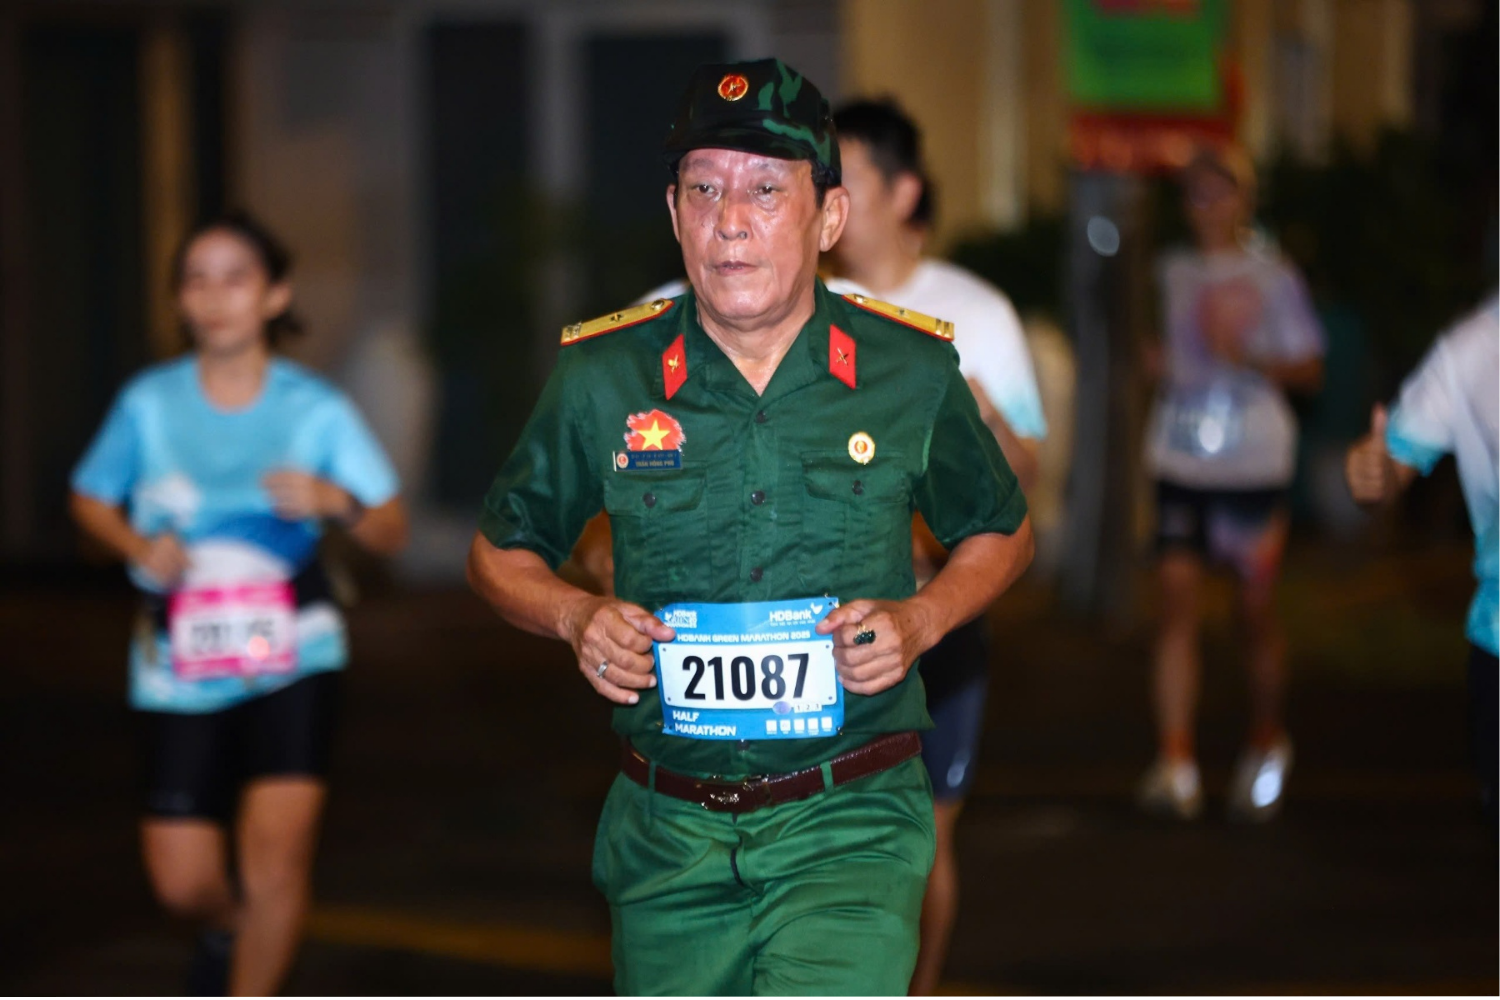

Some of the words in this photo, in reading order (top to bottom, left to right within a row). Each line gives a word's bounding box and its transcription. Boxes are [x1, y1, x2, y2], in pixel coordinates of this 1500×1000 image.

[769, 610, 811, 621] HDBank
[677, 633, 711, 643] HDBANK
[713, 633, 739, 643] GREEN
[741, 631, 789, 642] MARATHON
[791, 630, 810, 640] 2025
[682, 653, 809, 701] 21087
[672, 711, 699, 722] HALF
[674, 723, 736, 736] MARATHON
